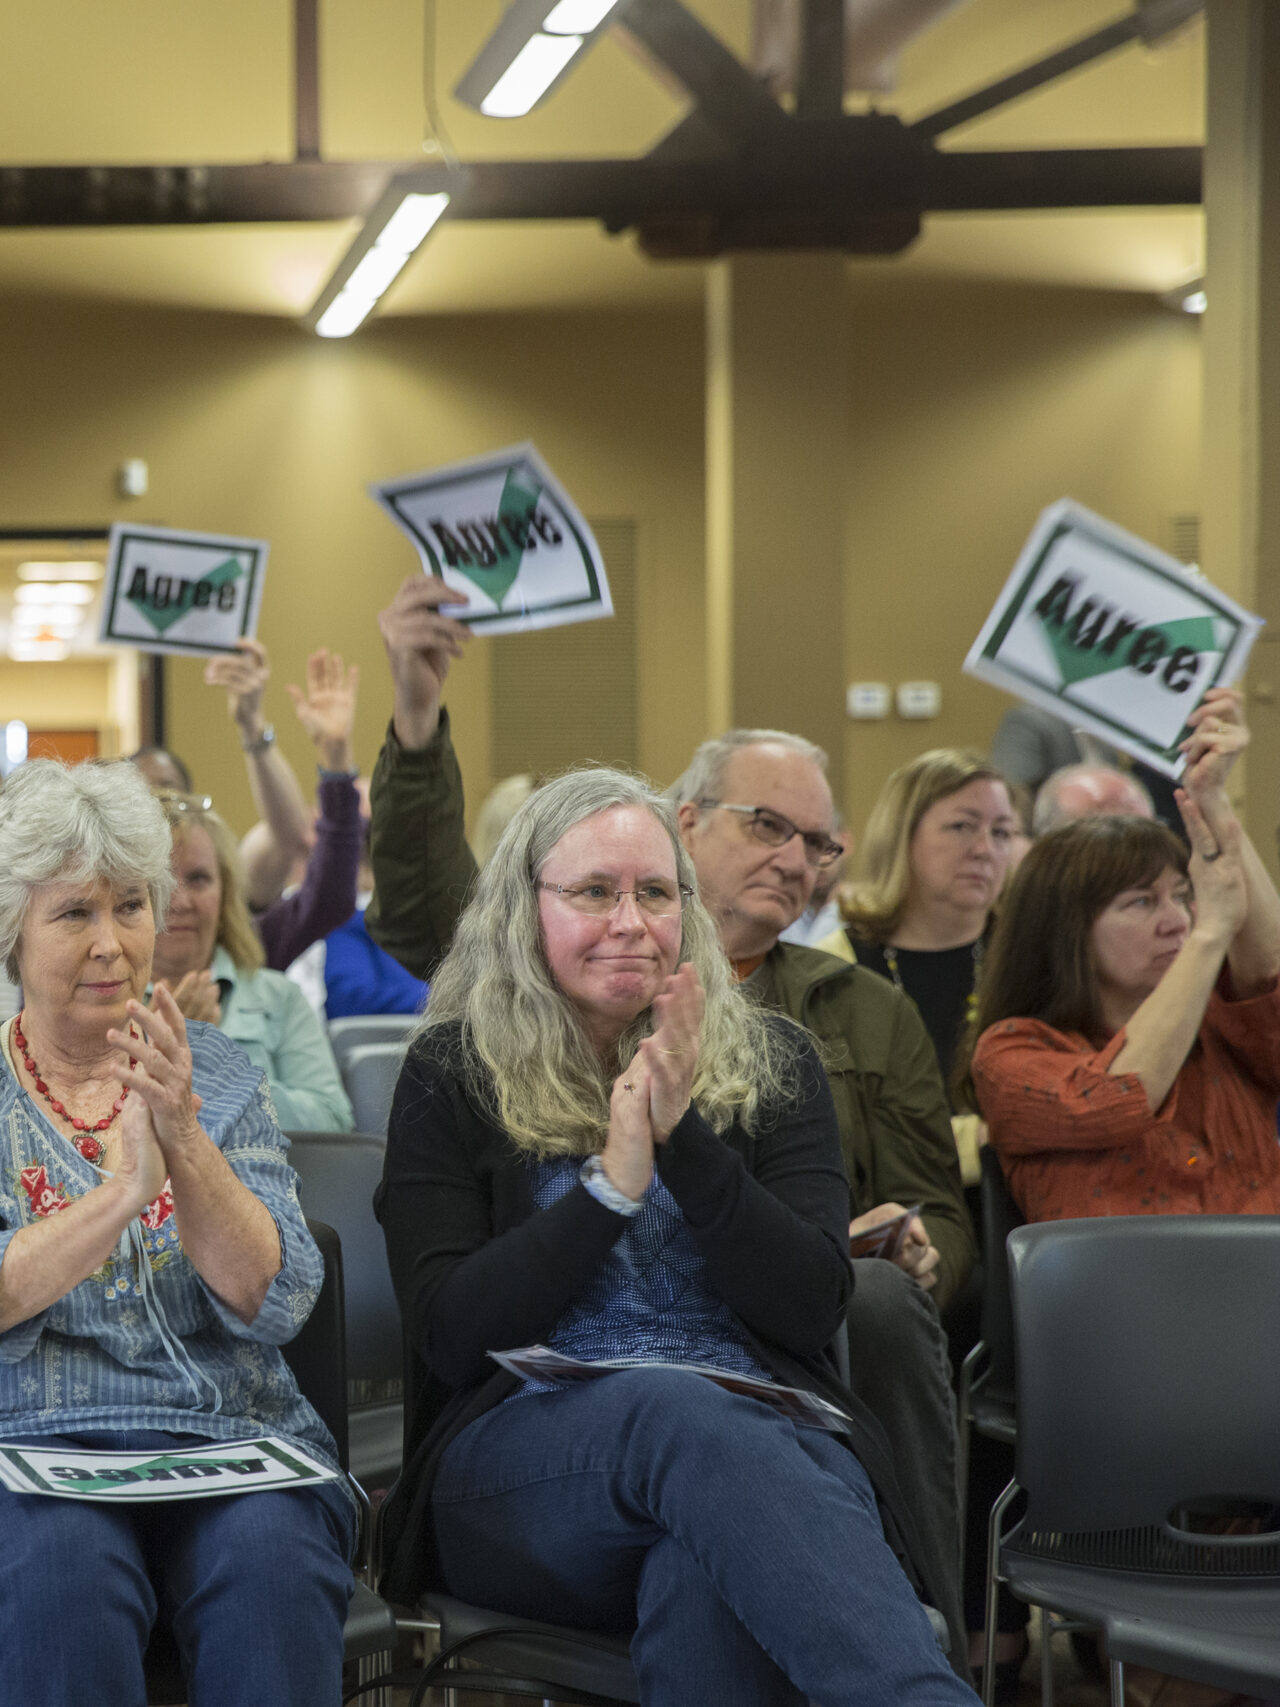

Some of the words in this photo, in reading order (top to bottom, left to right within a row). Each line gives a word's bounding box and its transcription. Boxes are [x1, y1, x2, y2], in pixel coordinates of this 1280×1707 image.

[426, 506, 564, 571] Agree
[126, 566, 236, 613] Agree
[1030, 573, 1201, 693] Agree
[47, 1457, 270, 1482] Agree
